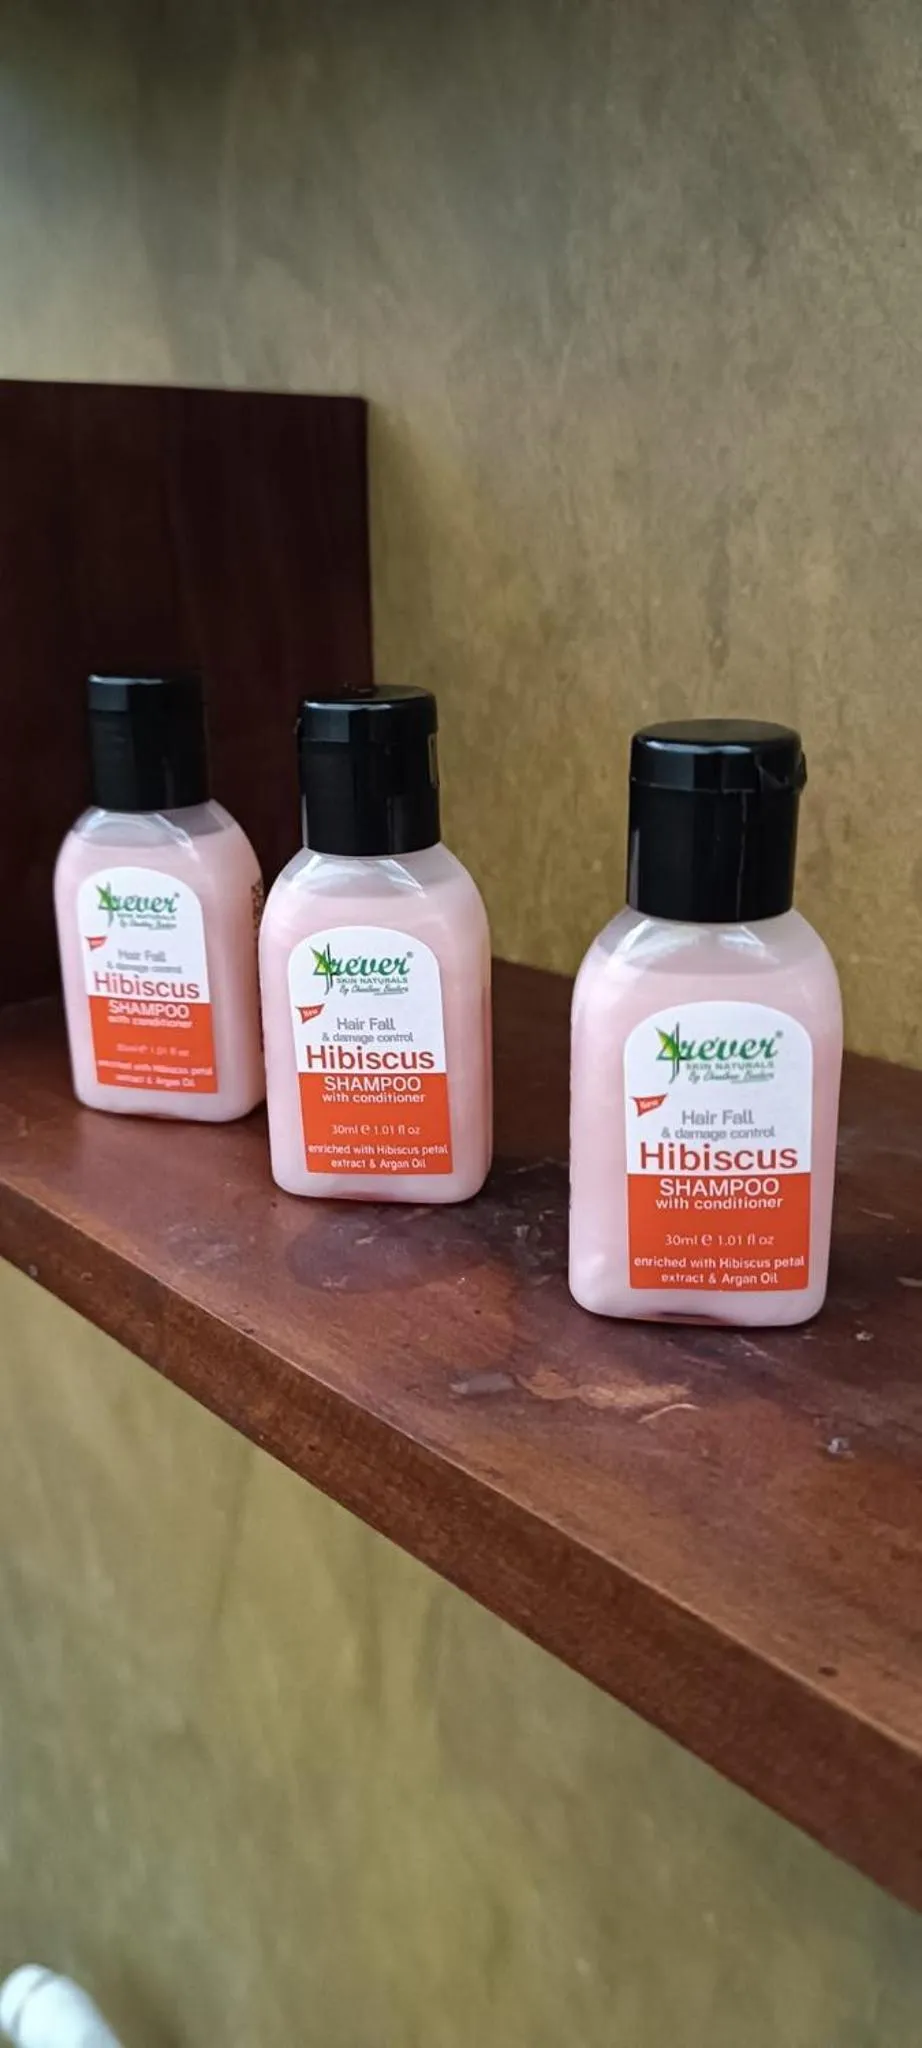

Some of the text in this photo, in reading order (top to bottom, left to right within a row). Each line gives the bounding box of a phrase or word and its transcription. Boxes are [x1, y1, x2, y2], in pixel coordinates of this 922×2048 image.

[94, 970, 200, 999] Hibiscus
[108, 1000, 190, 1018] SHAMPOO
[336, 1017, 396, 1031] Hair Fall
[322, 1032, 414, 1045] & damage control
[306, 1045, 435, 1070] Hibiscus
[715, 1061, 775, 1070] NATURALS
[324, 1076, 422, 1092] SHAMPOO
[322, 1092, 426, 1103] with conditioner
[681, 1109, 754, 1125] Hair Fall
[374, 1124, 395, 1135] 1.01
[409, 1126, 421, 1135] oz
[661, 1126, 775, 1141] & damage control
[308, 1144, 448, 1156] enriched with Hibiscus petal
[640, 1142, 798, 1171] Hibiscus
[331, 1159, 366, 1168] extract
[380, 1159, 409, 1170] Argan
[412, 1158, 426, 1168] Oil
[660, 1178, 780, 1196] SHAMPOO
[656, 1196, 784, 1210] with conditioner
[665, 1234, 698, 1245] 30ml
[717, 1234, 742, 1245] 1.01
[759, 1235, 775, 1245] oz
[634, 1256, 805, 1270] enriched with Hibiscus petal
[661, 1272, 777, 1287] extract & Argan Oil
